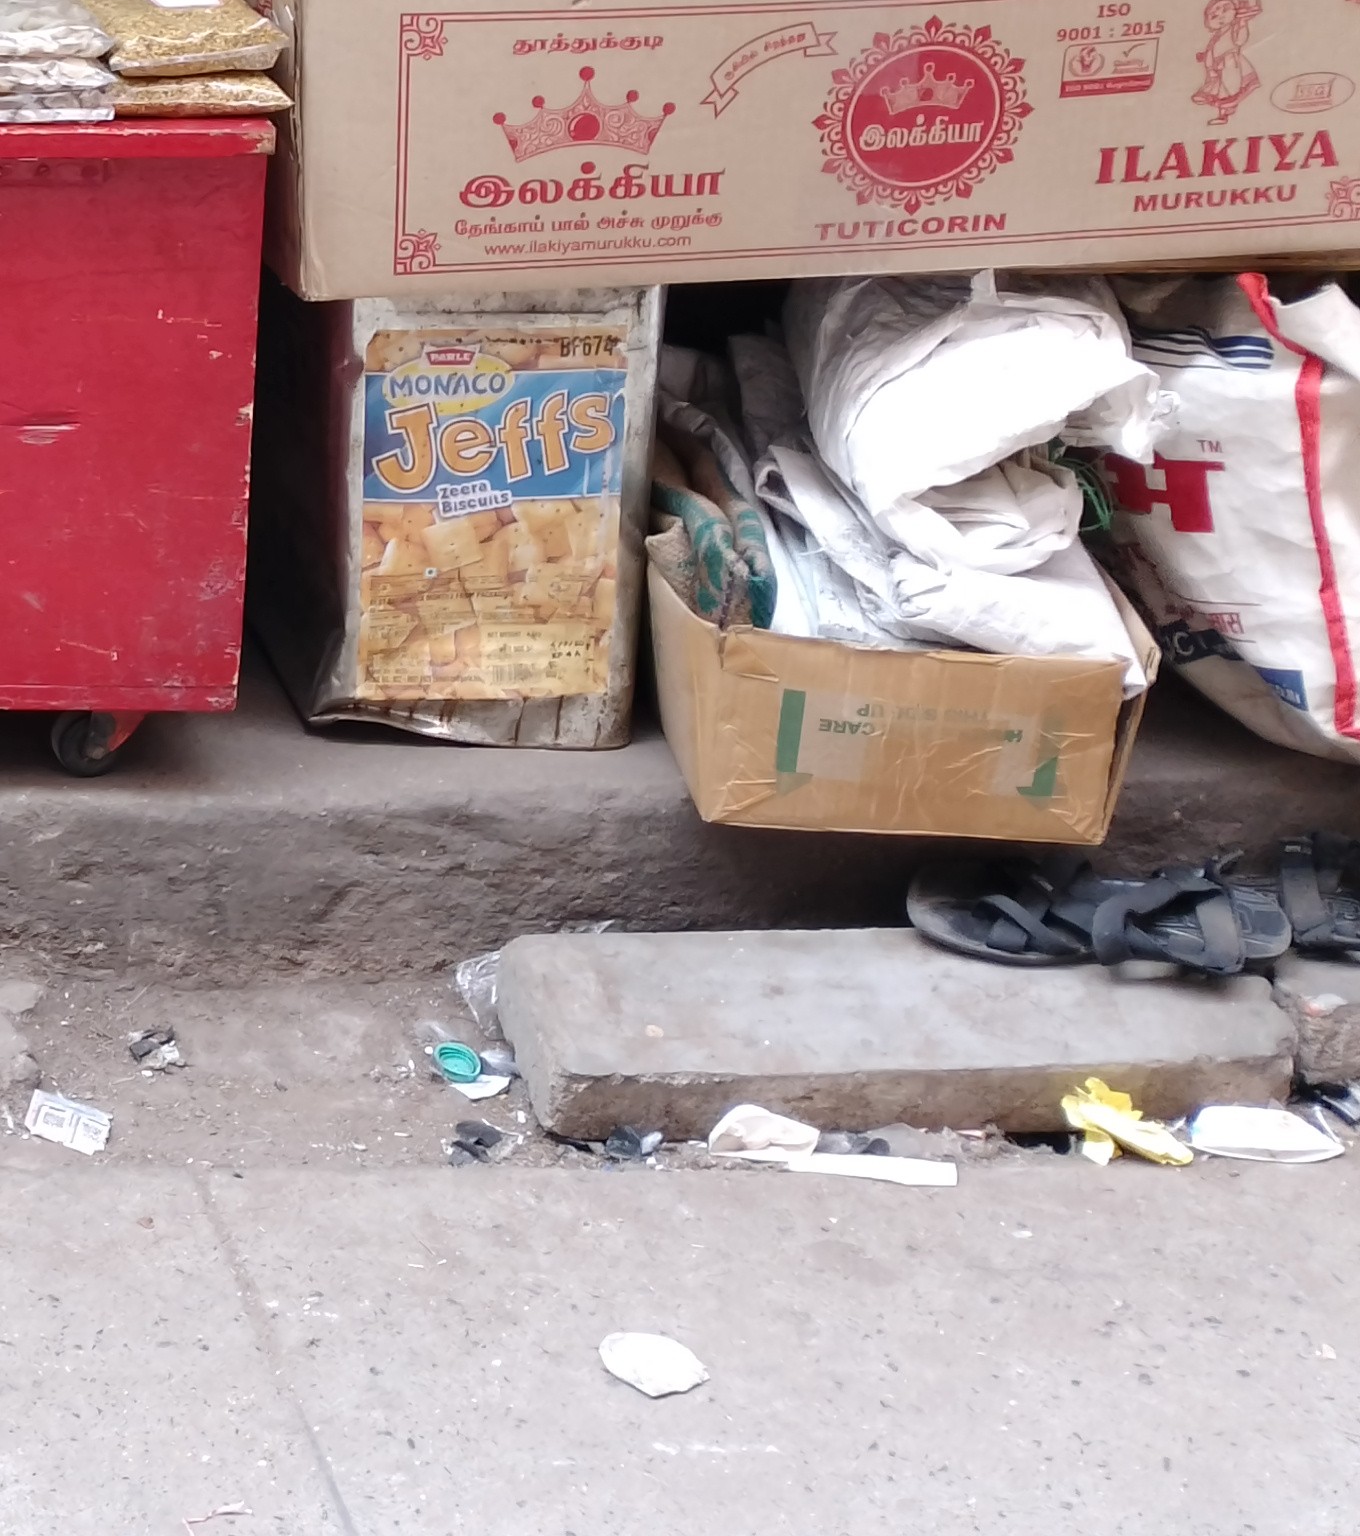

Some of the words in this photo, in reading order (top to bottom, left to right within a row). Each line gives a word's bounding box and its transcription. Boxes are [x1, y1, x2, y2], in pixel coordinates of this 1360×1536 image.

[1097, 3, 1131, 18] ISO
[512, 31, 665, 56] தூத்துக்குடி
[1056, 26, 1101, 42] 9001
[1121, 20, 1166, 37] 2015
[858, 113, 984, 153] இலக்கியா
[1095, 130, 1338, 184] ILAKIYA
[459, 161, 726, 210] இலக்கியா
[1133, 184, 1298, 212] MURUKKU
[455, 215, 545, 239] தேங்காய்
[551, 211, 590, 232] பால்
[596, 209, 645, 230] அச்சு
[651, 207, 724, 231] முறுக்கு
[815, 212, 1007, 241] TUTICORIN
[484, 235, 692, 256] www.ilakiyamurukku.com
[428, 350, 477, 366] PARLE
[388, 371, 508, 400] MONACO
[371, 390, 616, 494] Jeffs
[1197, 439, 1223, 453] TM
[438, 481, 488, 499] Zeera
[441, 491, 511, 514] Biscuits
[818, 717, 876, 737] CARE
